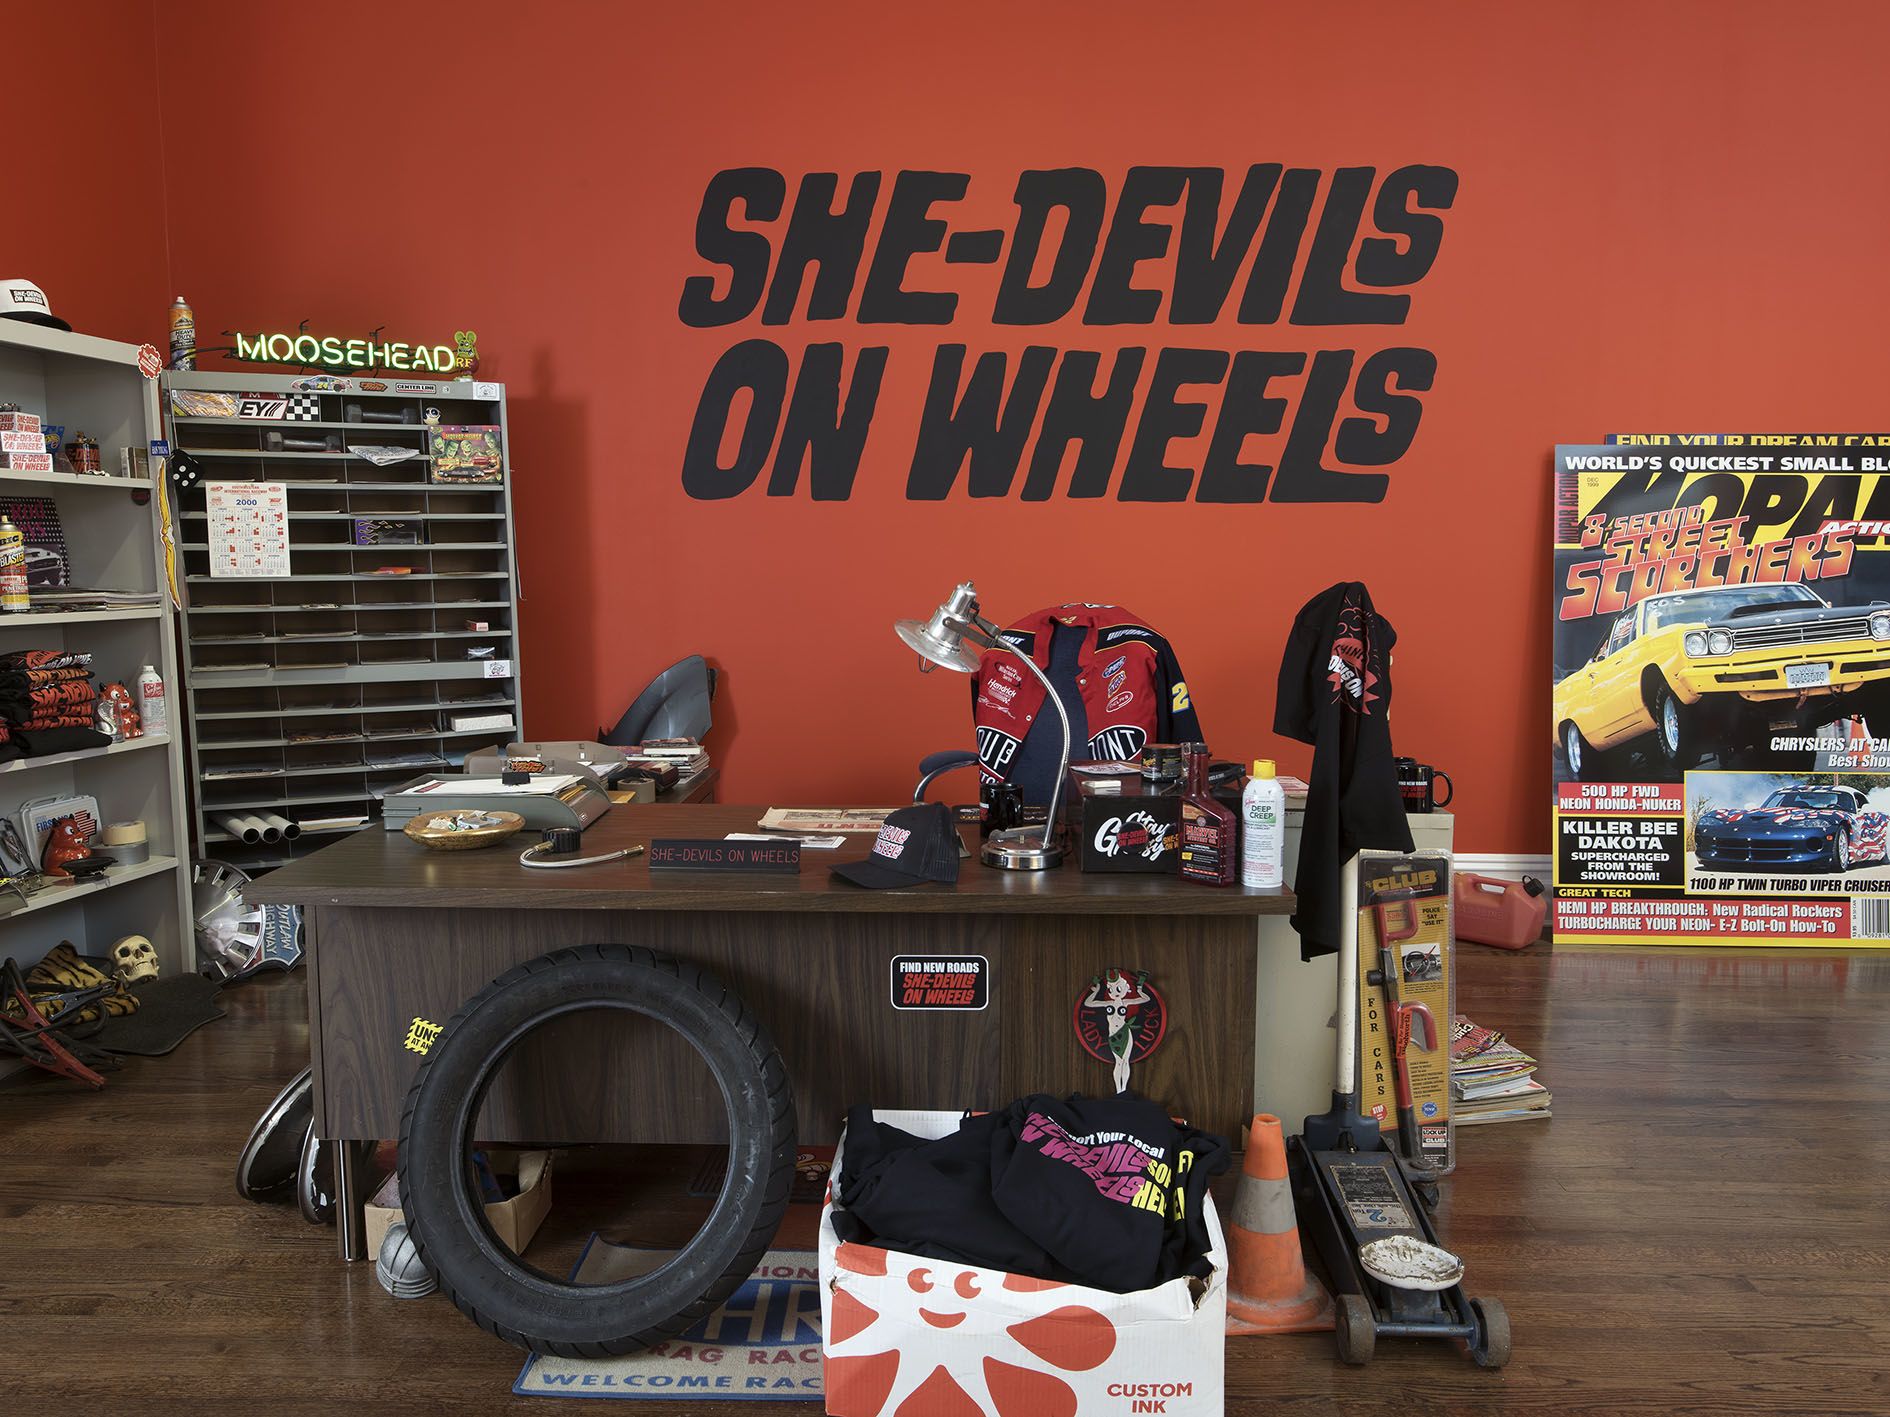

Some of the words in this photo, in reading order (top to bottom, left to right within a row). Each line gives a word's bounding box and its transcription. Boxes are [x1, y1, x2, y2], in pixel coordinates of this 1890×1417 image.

[678, 163, 1459, 327] SHE-DEVILS
[236, 332, 456, 372] MOOSEHEAD
[456, 358, 473, 368] RF
[681, 338, 890, 501] ON
[906, 343, 1437, 503] WHEELS
[1565, 456, 1662, 471] WORLD'S
[1669, 457, 1774, 472] QUICKEST
[1780, 456, 1854, 471] SMALL
[1602, 515, 1751, 573] STREET
[1559, 528, 1858, 621] SCORCHERS
[988, 678, 1017, 698] Hendrick
[1770, 736, 1846, 752] CHRYSLERS
[1849, 738, 1867, 752] AT
[1828, 754, 1858, 767] Best
[1581, 785, 1608, 798] 500
[1610, 785, 1629, 798] HP
[1632, 785, 1660, 798] FWD
[1251, 805, 1271, 813] DEEP
[1560, 798, 1592, 810] NEON
[1595, 798, 1682, 811] HONDA-NUKER
[1249, 812, 1274, 820] CREEP
[1563, 821, 1633, 836] KILLER
[1640, 822, 1678, 836] BEE
[1578, 836, 1663, 850] DAKOTA
[651, 847, 723, 862] SHE-DEVILS
[728, 848, 745, 862] ON
[750, 849, 799, 864] WHEELS
[1571, 852, 1670, 862] SUPERCHARGED
[1587, 861, 1623, 871] FROM
[1628, 862, 1653, 871] THE
[1372, 870, 1438, 892] CLUB
[1580, 871, 1661, 881] SHOWROOM!
[1690, 877, 1717, 891] 1100
[1719, 878, 1735, 891] HP
[1737, 878, 1768, 891] TWIN
[1770, 878, 1808, 892] TURBO
[1810, 879, 1843, 892] VIPER
[1558, 889, 1598, 898] GREAT
[1600, 889, 1631, 898] TECH
[1557, 901, 1588, 915] HEMI
[1590, 902, 1608, 915] HP
[1611, 902, 1709, 916] BREAKTHROUGH:
[1712, 903, 1738, 917] New
[1743, 904, 1789, 917] Radical
[1792, 904, 1843, 918] Rockers
[1557, 916, 1642, 931] TURBOCHARGE
[1645, 917, 1677, 931] YOUR
[1680, 918, 1716, 931] NEON-
[1719, 918, 1738, 932] E-Z
[1741, 919, 1787, 932] Bolt-On
[1790, 919, 1837, 933] How-To
[900, 962, 922, 973] FIND
[923, 962, 945, 973] NEW
[947, 962, 980, 974] ROADS
[903, 973, 977, 989] SHE-DEVILS
[903, 989, 922, 1005] ON
[924, 988, 975, 1005] WHEELS
[1368, 998, 1379, 1032] FOR
[1080, 1009, 1107, 1051] LADY
[1134, 1008, 1160, 1051] LUCK
[1373, 1047, 1385, 1095] CARS
[1096, 1131, 1127, 1145] Your
[1127, 1134, 1165, 1160] Local
[542, 1373, 732, 1389] WELCOME
[1106, 1382, 1193, 1398] CUSTOM
[1131, 1400, 1166, 1414] INK
